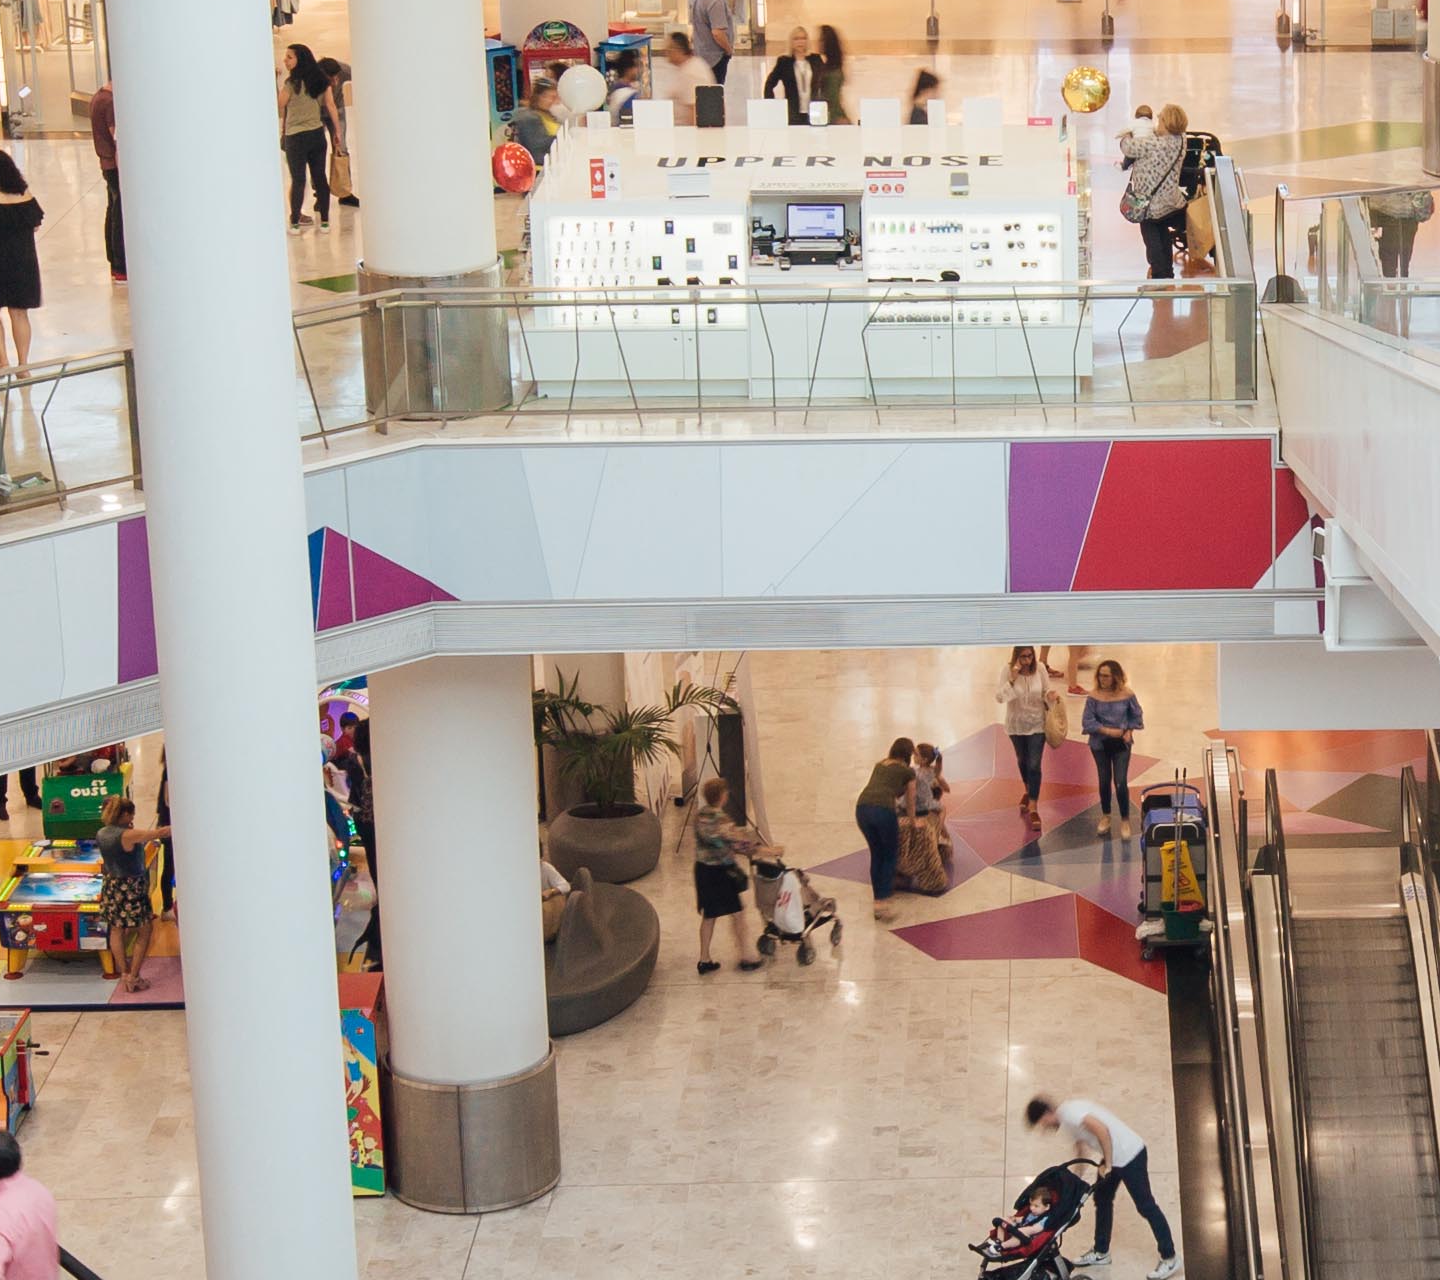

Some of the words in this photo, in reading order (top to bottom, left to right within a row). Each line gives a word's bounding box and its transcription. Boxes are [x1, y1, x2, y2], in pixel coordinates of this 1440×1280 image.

[657, 155, 838, 168] UPPER
[863, 155, 1004, 168] NOSE
[70, 786, 108, 797] OUSE
